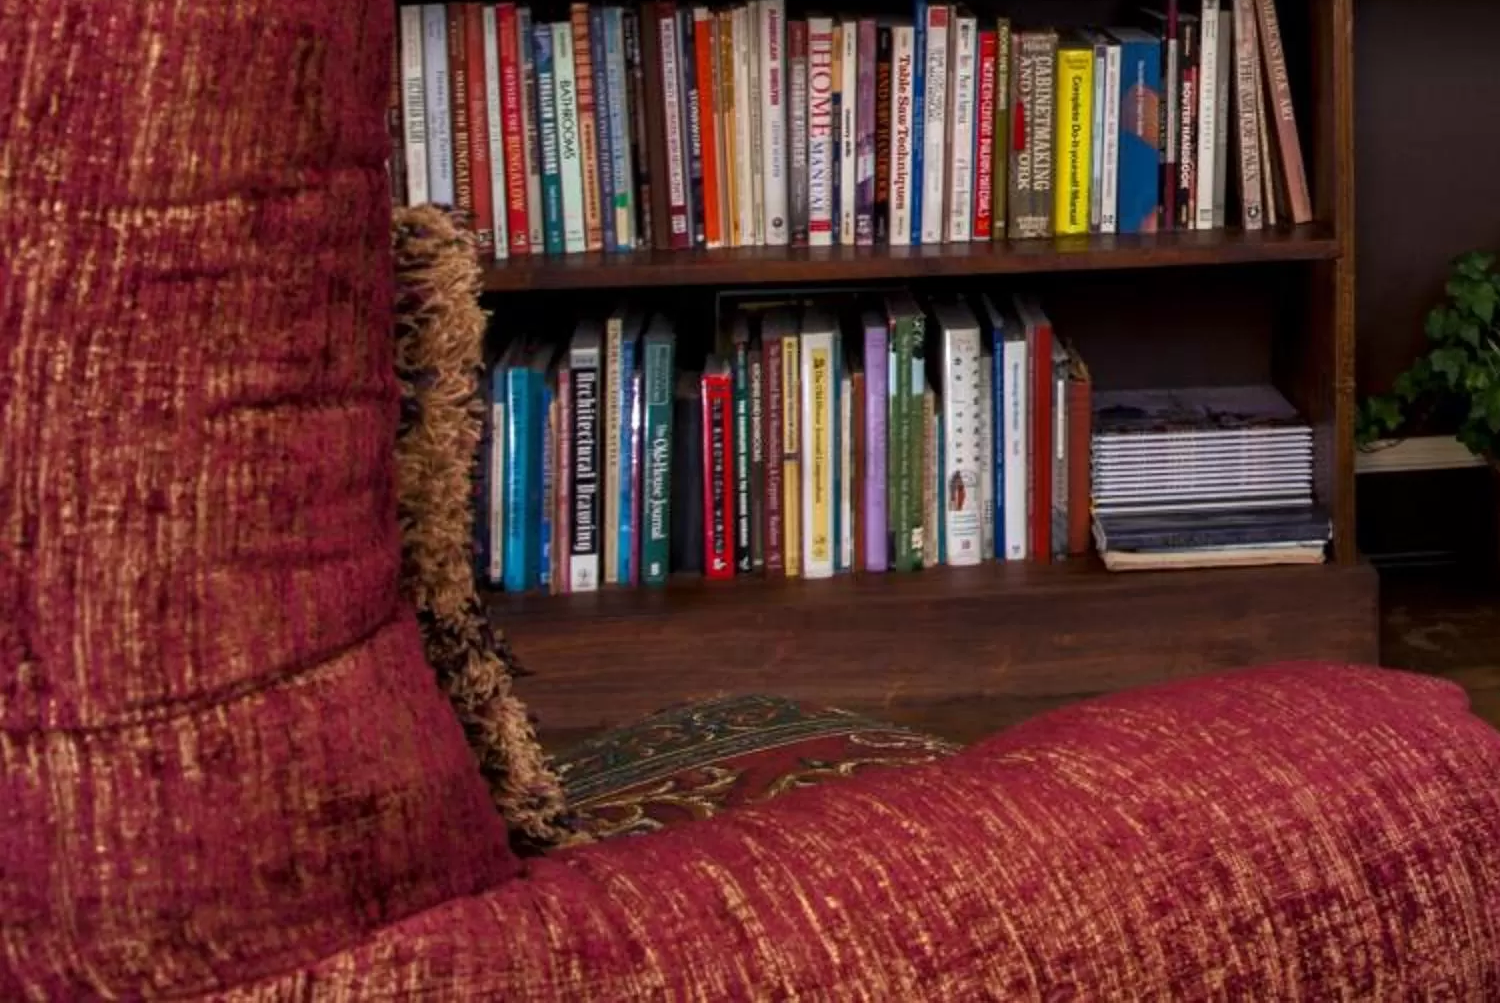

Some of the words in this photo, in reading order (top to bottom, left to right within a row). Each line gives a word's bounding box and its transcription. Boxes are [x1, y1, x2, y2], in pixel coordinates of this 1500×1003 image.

[768, 9, 780, 61] AMERICAN
[811, 49, 833, 137] HOME
[897, 54, 911, 94] Table
[1020, 56, 1033, 92] AND
[1070, 76, 1083, 121] Complete
[1240, 55, 1253, 86] THE
[456, 109, 467, 127] THE
[507, 113, 519, 132] THE
[560, 80, 576, 159] BATHROOMS
[897, 96, 909, 125] Saw
[1033, 56, 1052, 191] CABINETMAKING
[1183, 82, 1192, 125] ROUTER
[1280, 97, 1294, 121] ART
[456, 132, 471, 209] BUNGALOW
[506, 135, 525, 213] BUNGALOW
[810, 141, 825, 213] MANUAL
[876, 129, 889, 203] HANDBOOK
[894, 127, 909, 210] Techniques
[1181, 127, 1191, 189] HANDBOOK
[575, 372, 596, 481] Architectural
[652, 438, 667, 497] Old-House
[573, 484, 596, 552] Drawing
[650, 499, 667, 540] Journal
